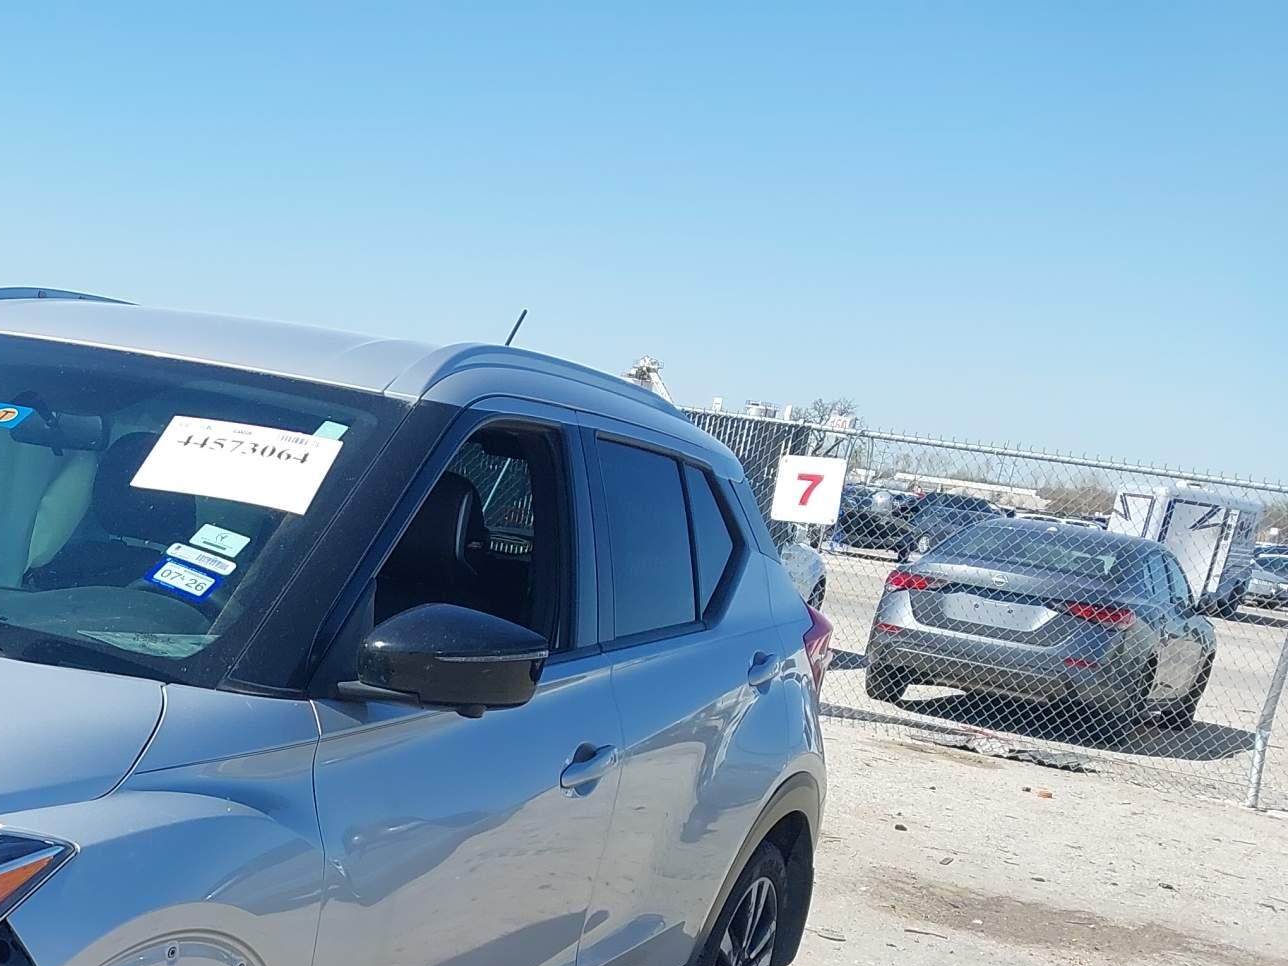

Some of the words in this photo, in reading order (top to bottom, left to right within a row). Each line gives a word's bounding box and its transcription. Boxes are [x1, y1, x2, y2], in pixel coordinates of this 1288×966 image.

[177, 434, 310, 465] 44573064
[797, 473, 824, 506] 7
[160, 569, 183, 581] 07
[185, 578, 208, 592] 26
